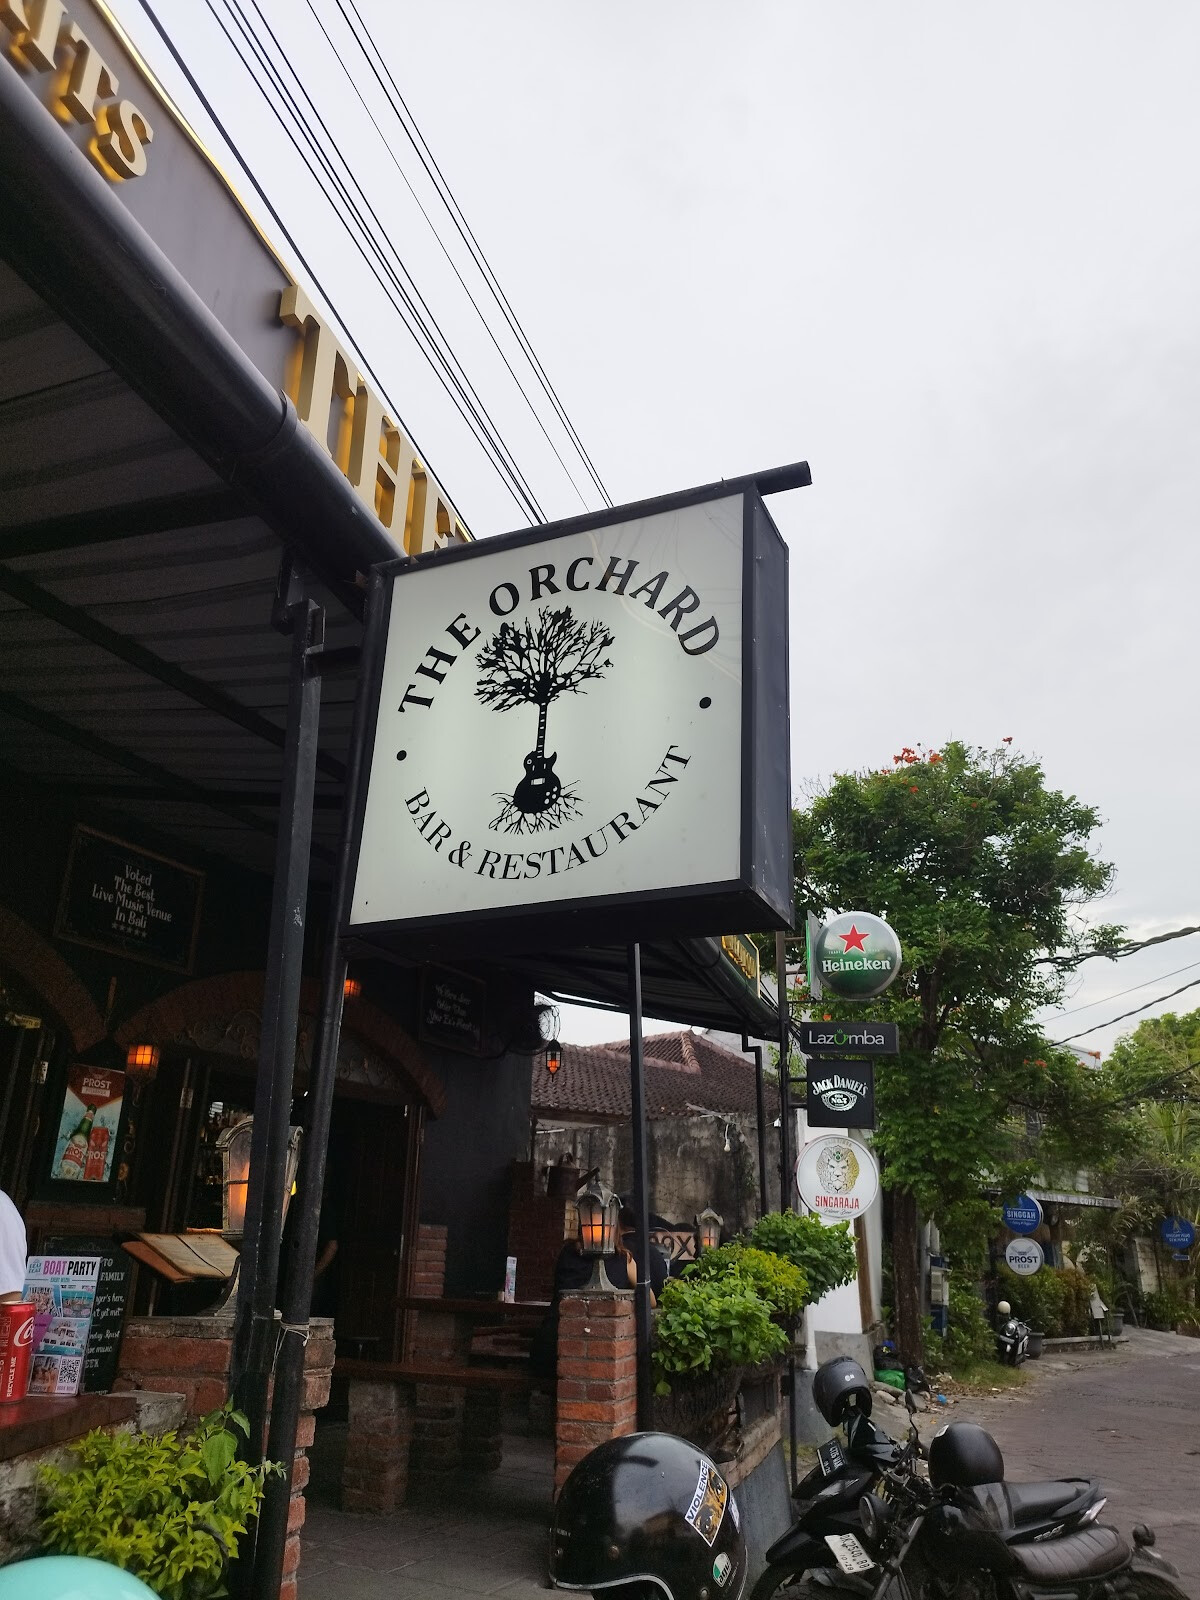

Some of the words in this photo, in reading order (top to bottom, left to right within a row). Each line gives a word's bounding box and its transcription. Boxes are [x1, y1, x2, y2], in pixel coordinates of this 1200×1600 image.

[0, 0, 153, 179] ITS
[398, 612, 482, 714] THE
[488, 555, 720, 656] ORCHARD
[404, 786, 453, 853] BAR
[447, 840, 474, 869] &
[474, 744, 692, 880] RESTAURANT
[125, 865, 152, 886] Voted
[114, 875, 133, 894] The
[134, 883, 155, 902] Best
[92, 884, 114, 902] Live
[115, 891, 144, 913] Music
[147, 902, 172, 922] Venue
[115, 907, 126, 922] In
[128, 911, 147, 928] Bali
[822, 958, 891, 973] Heineken
[82, 1077, 112, 1090] PROST
[812, 1078, 834, 1096] JACK
[815, 1195, 860, 1209] SINGARAJA
[1006, 1209, 1036, 1220] SINGGAH
[43, 1260, 67, 1275] BOAT
[67, 1260, 96, 1276] PARTY
[1009, 1255, 1038, 1264] PROST
[100, 1272, 125, 1281] FAMILY
[10, 1356, 17, 1368] ME
[7, 1368, 16, 1397] RECYCLE
[687, 1460, 708, 1520] VIOLENCE
